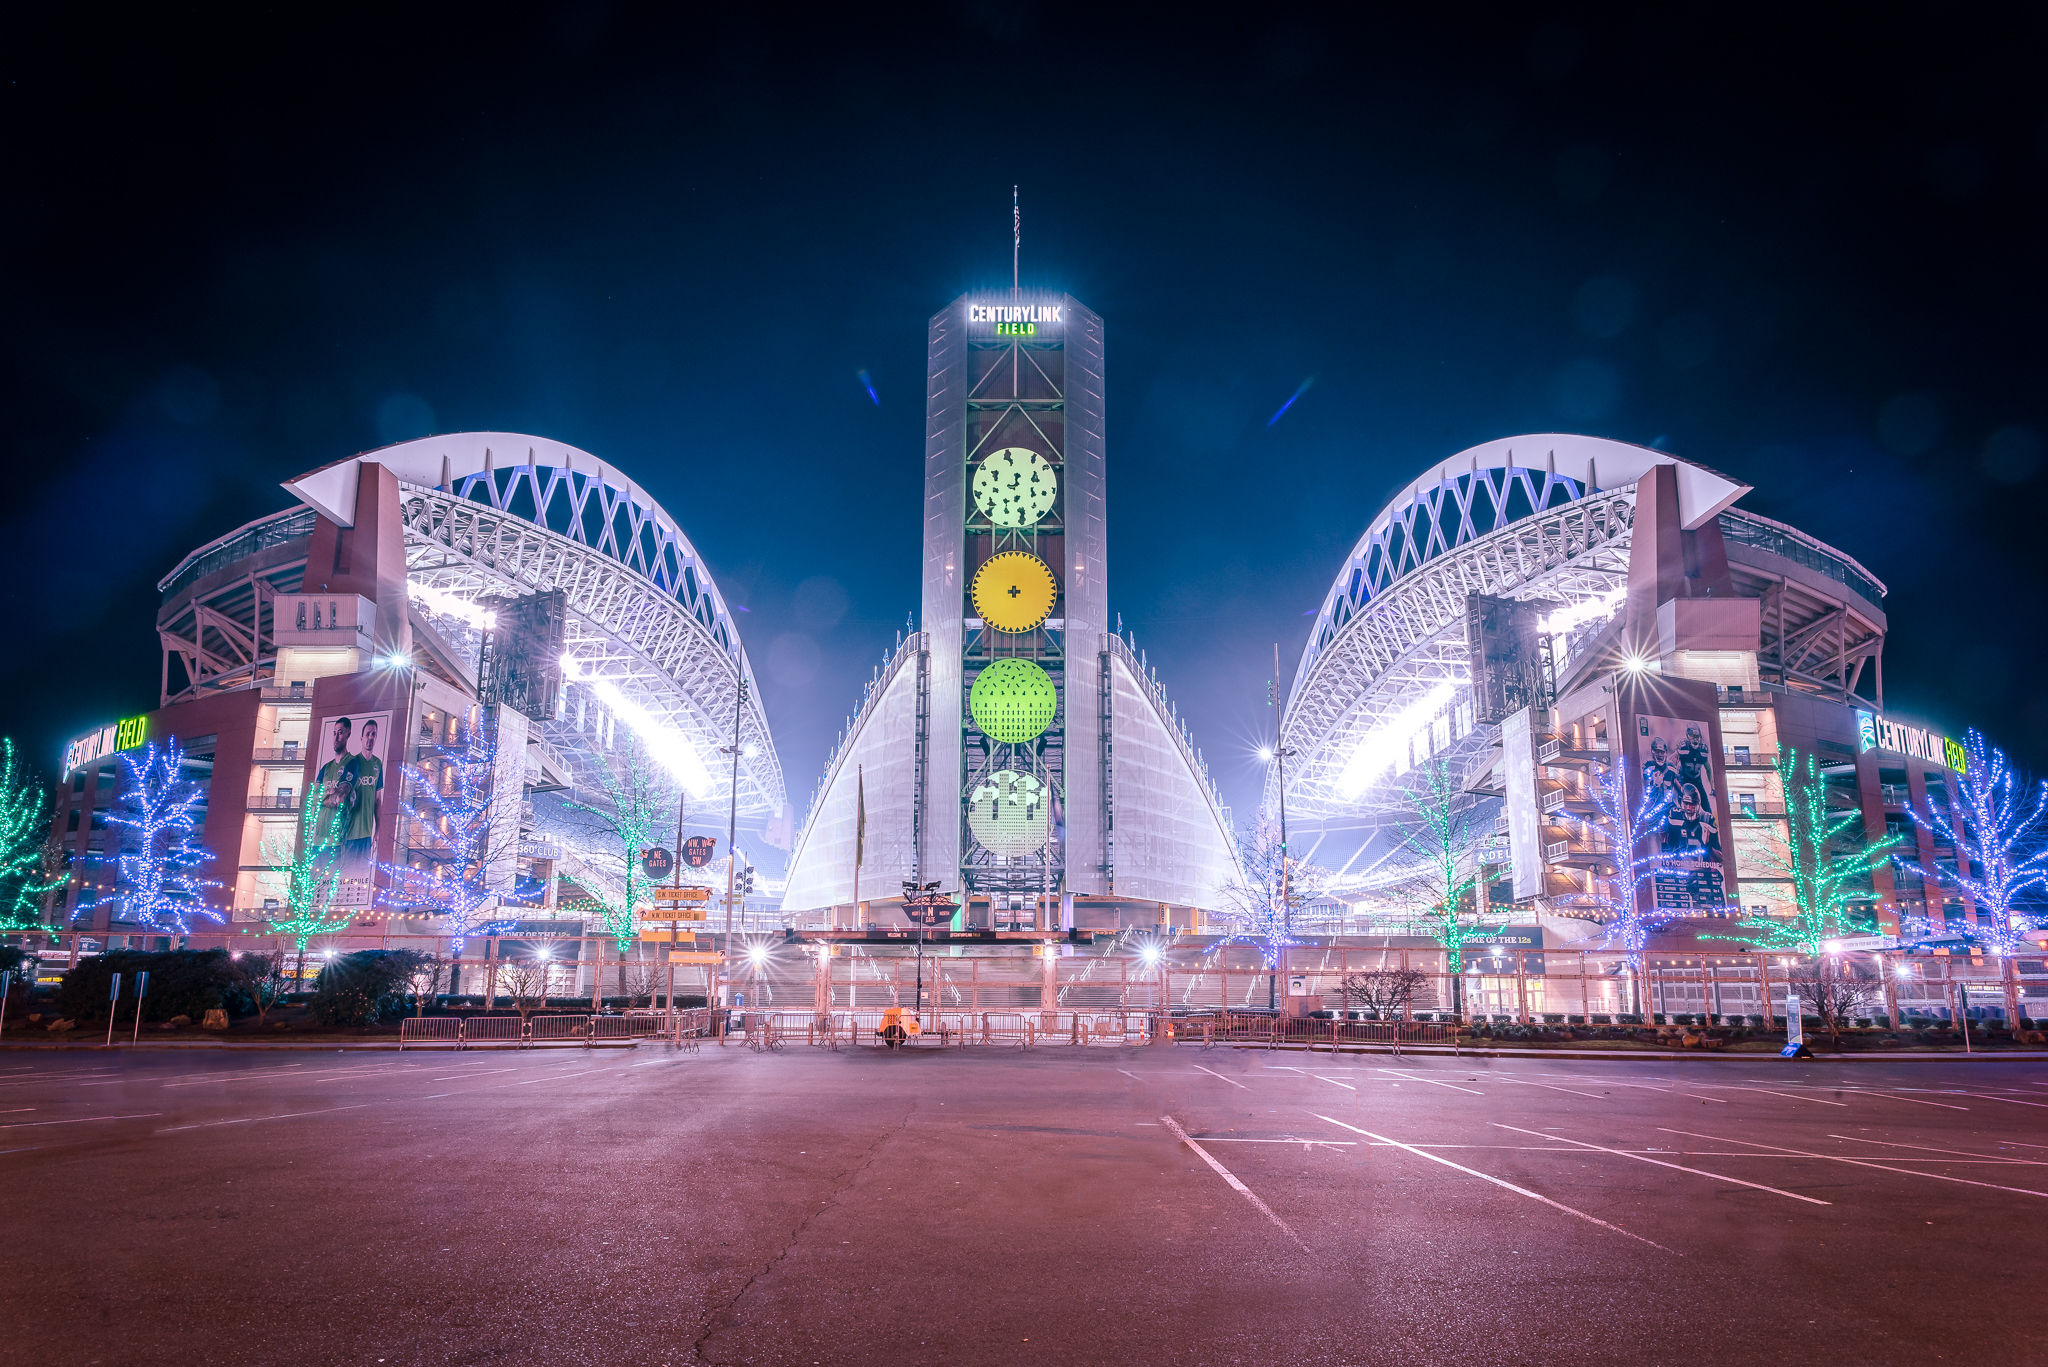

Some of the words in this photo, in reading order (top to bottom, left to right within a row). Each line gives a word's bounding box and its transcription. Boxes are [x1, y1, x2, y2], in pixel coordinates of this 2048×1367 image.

[970, 304, 1061, 322] CENTURYLINK
[997, 323, 1035, 335] FIELD
[115, 716, 147, 752] FIELD
[1876, 714, 1947, 767] CENTURYLINK
[358, 775, 378, 786] XBOX
[537, 846, 559, 857] CLUB
[653, 850, 662, 859] NE
[688, 848, 706, 856] GATES
[648, 859, 667, 867] GATES
[691, 856, 702, 865] SW
[927, 906, 934, 917] N
[1486, 936, 1498, 944] OF
[1498, 936, 1517, 944] THE
